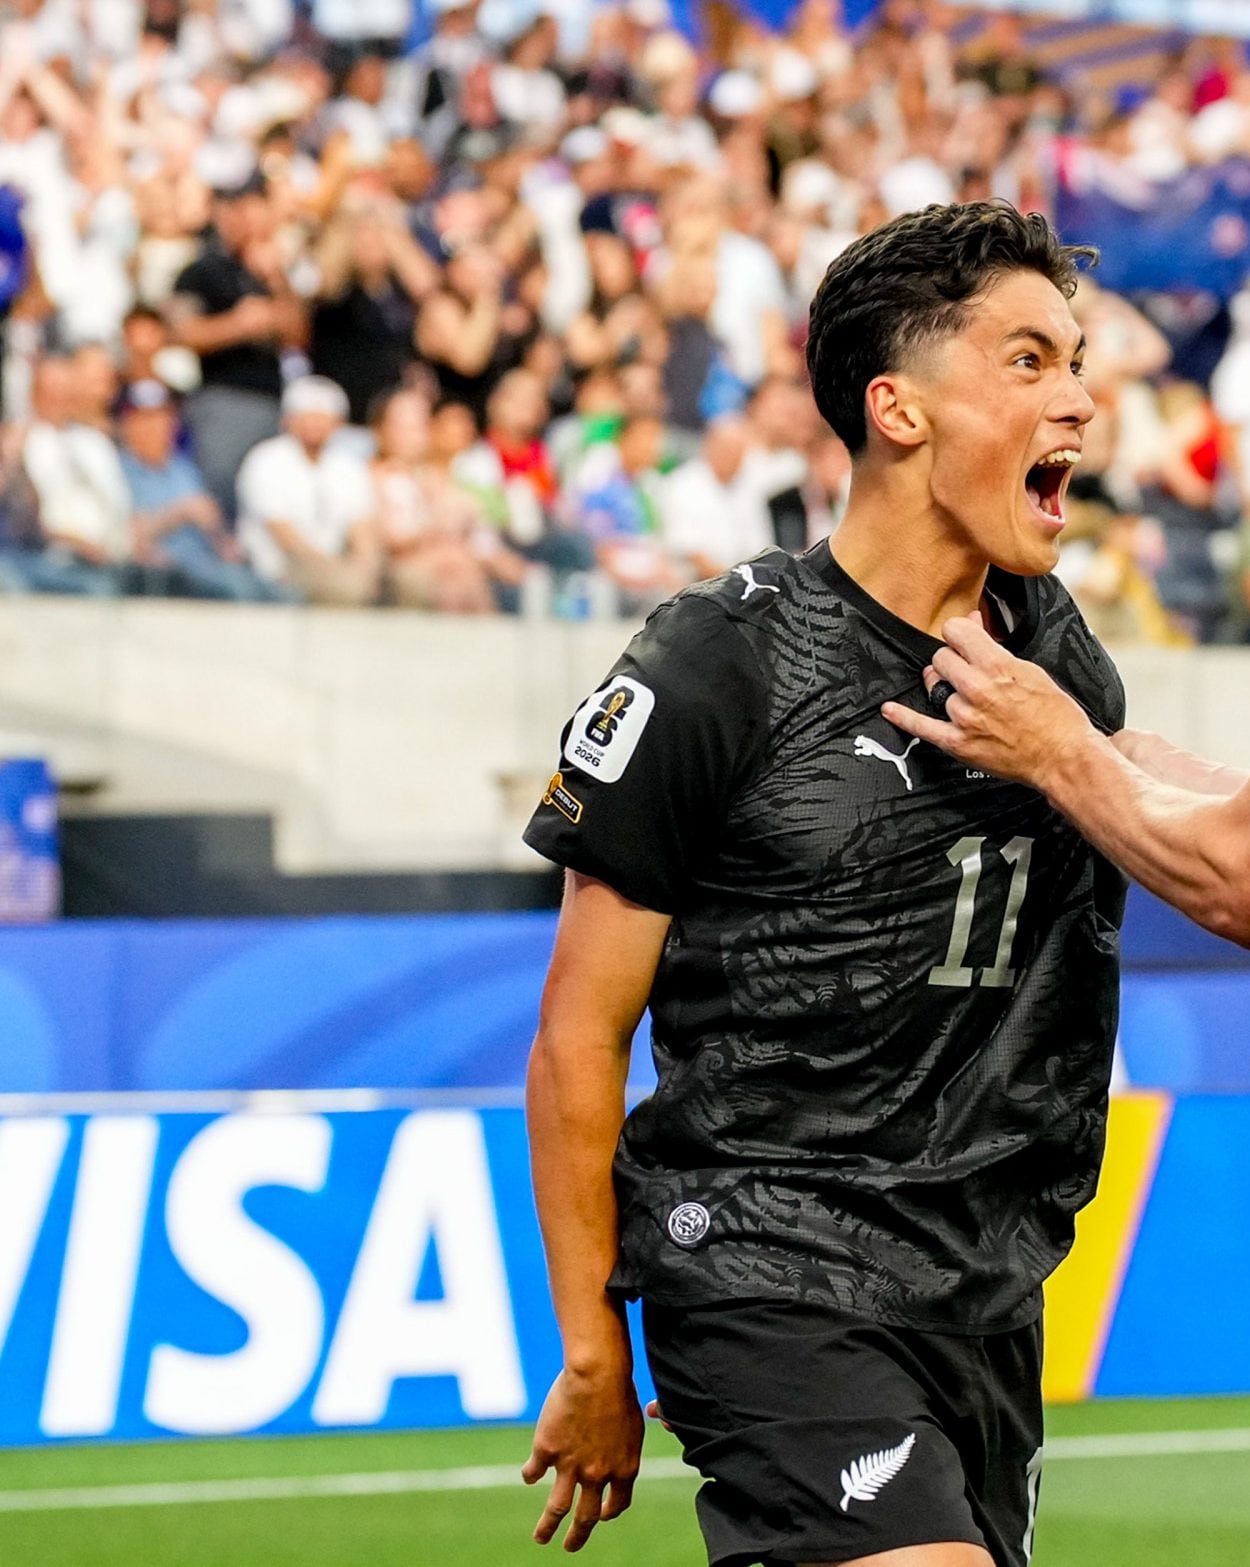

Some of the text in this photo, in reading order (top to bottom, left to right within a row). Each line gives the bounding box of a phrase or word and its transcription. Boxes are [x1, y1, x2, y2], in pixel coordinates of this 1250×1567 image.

[574, 745, 601, 767] 2026
[554, 788, 578, 812] DEBUT
[928, 836, 1036, 988] 11
